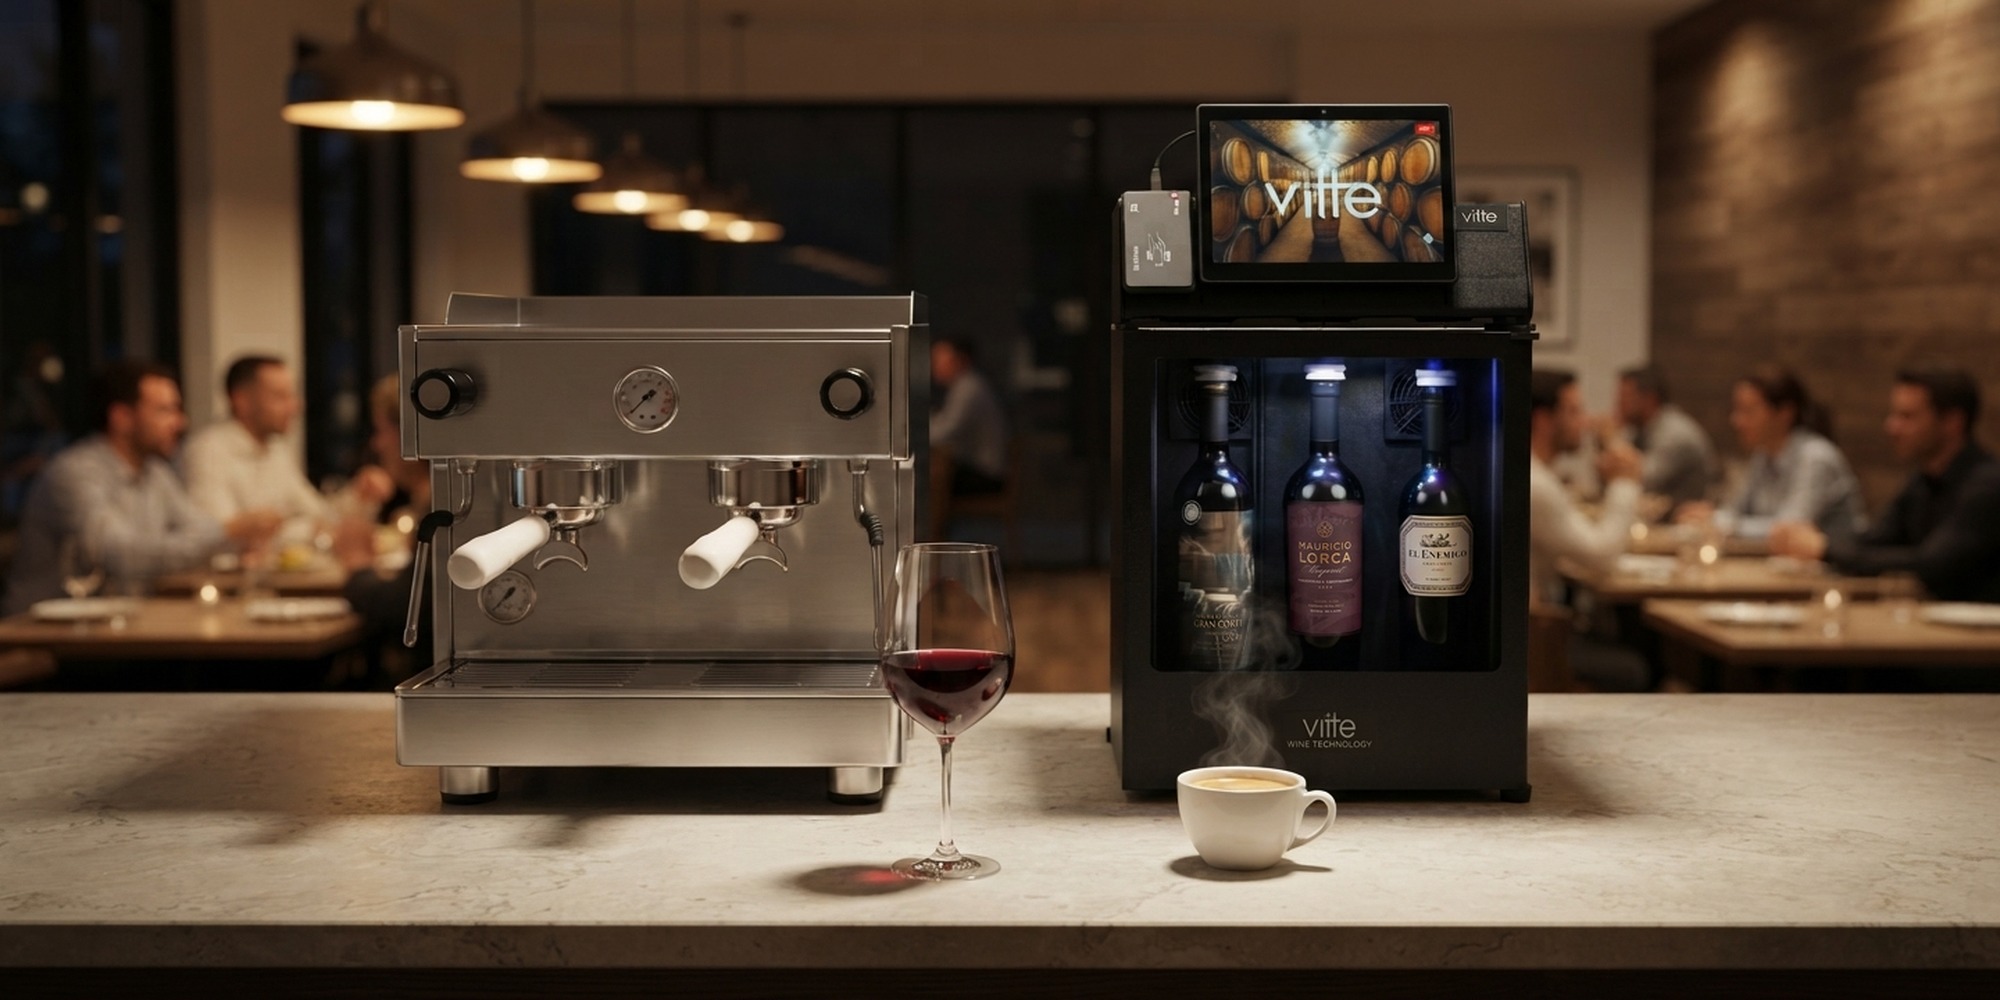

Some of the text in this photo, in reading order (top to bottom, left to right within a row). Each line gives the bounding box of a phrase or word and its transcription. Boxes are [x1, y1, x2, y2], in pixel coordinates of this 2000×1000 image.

[1265, 168, 1382, 220] vitte
[1461, 209, 1497, 223] vitte
[1298, 541, 1352, 551] MAURICIO
[1299, 552, 1352, 564] LORCA
[1409, 549, 1420, 558] EL
[1287, 740, 1372, 748] WINE TECHNOLOGY
